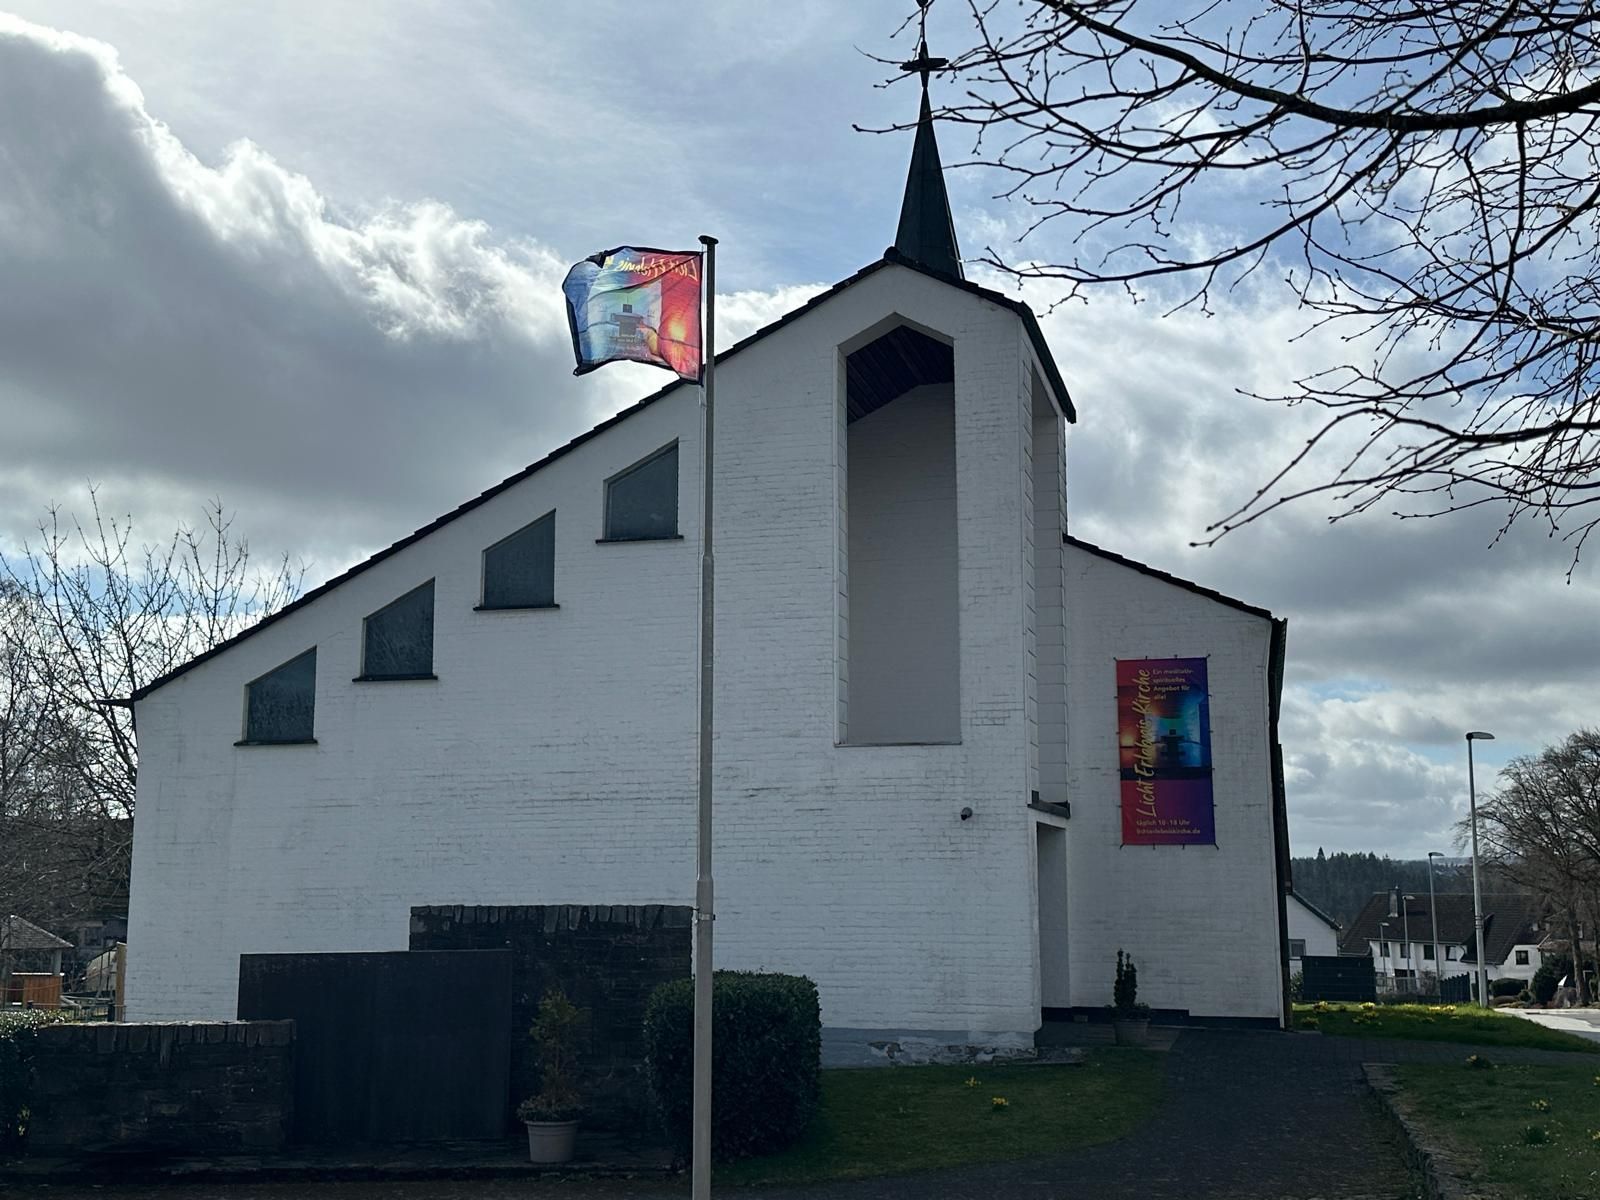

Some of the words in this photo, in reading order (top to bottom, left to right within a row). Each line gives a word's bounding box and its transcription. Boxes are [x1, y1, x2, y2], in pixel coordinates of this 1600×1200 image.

[1131, 669, 1152, 715] Kirche
[1136, 777, 1157, 818] Licht
[1178, 818, 1190, 826] Uhr
